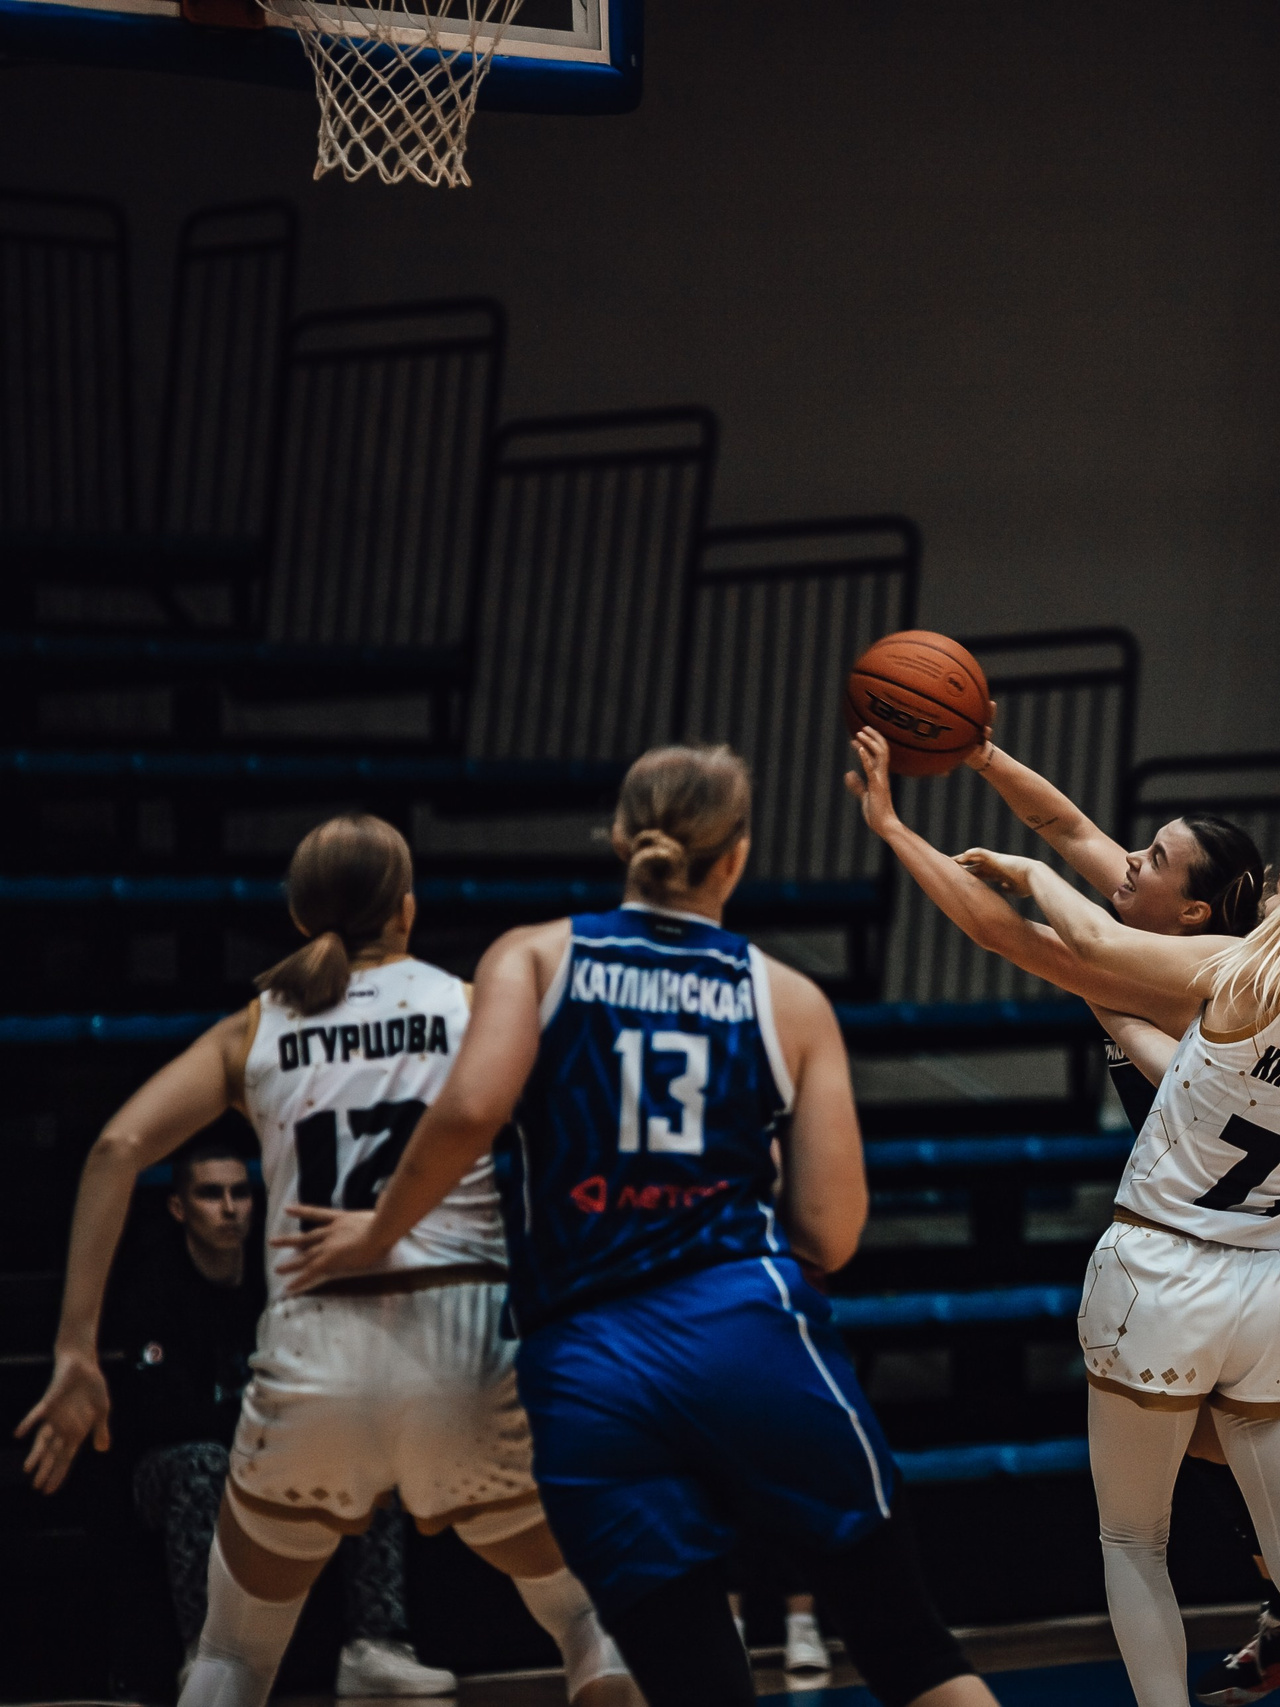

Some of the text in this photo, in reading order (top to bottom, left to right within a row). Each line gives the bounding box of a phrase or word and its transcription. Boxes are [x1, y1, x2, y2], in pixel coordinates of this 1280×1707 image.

[570, 958, 755, 1022] КАТЛИНСКАЯ
[279, 1013, 449, 1071] ОГУРЦОВА
[612, 1028, 711, 1156] 13
